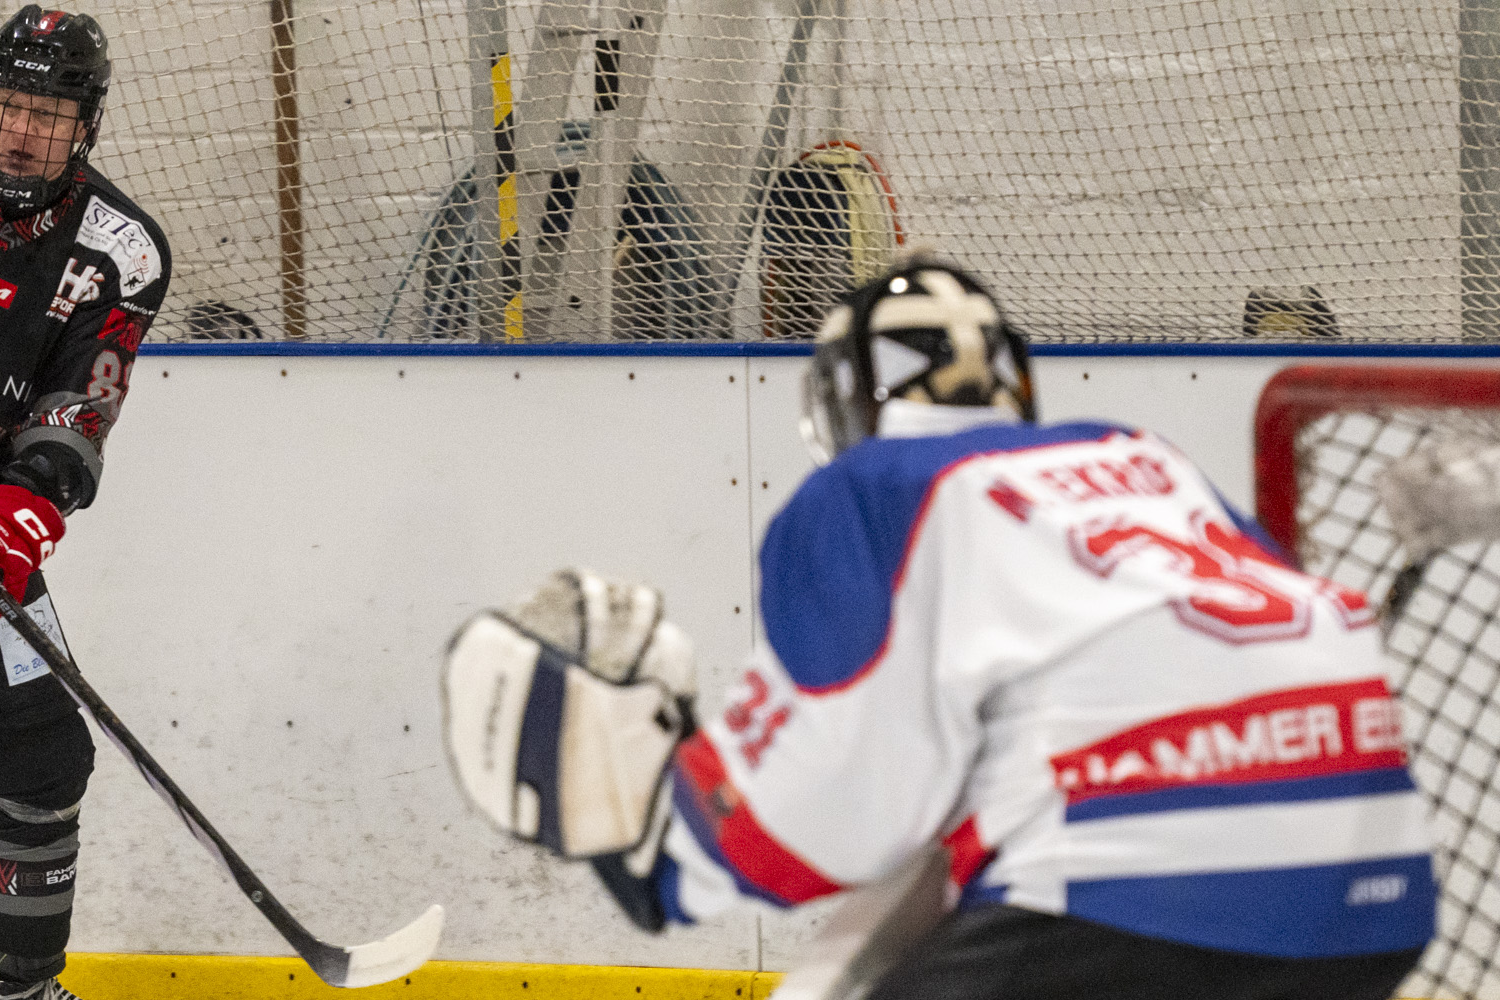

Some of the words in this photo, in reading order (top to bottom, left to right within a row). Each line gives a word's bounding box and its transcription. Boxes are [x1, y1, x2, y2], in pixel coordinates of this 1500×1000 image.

[13, 59, 51, 73] CCM
[85, 202, 151, 250] SiTec
[13, 663, 29, 675] Die
